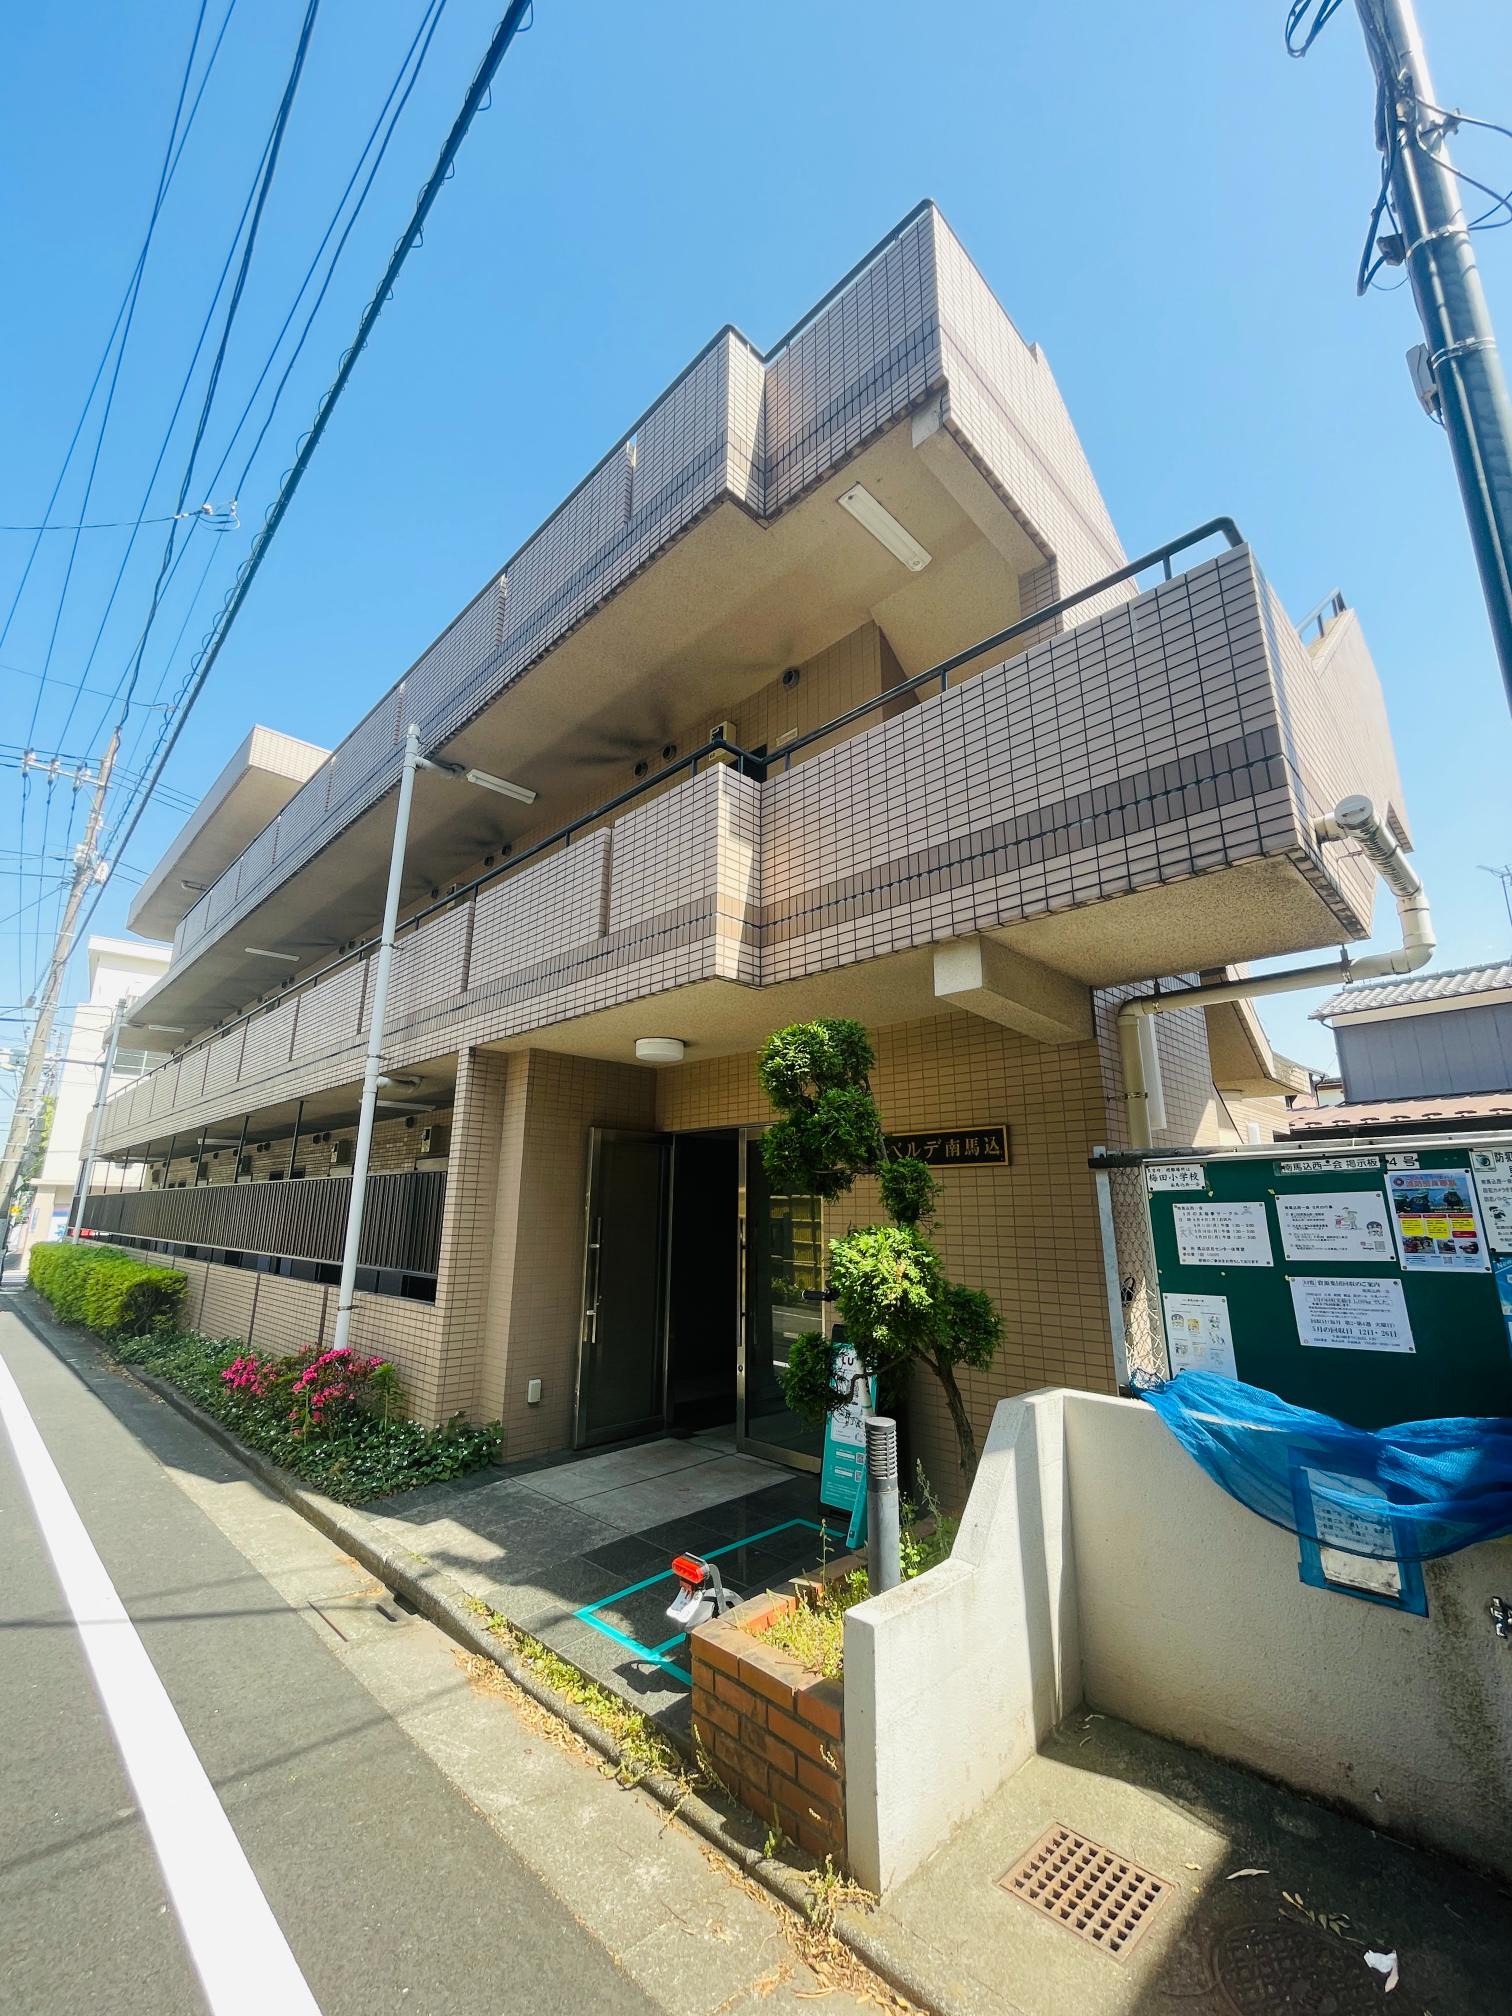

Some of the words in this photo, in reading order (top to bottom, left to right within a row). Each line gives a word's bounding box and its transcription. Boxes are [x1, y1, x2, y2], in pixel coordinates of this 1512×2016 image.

[1346, 1158, 1378, 1168] 掲示板
[1149, 1172, 1200, 1182] 梅田小学校
